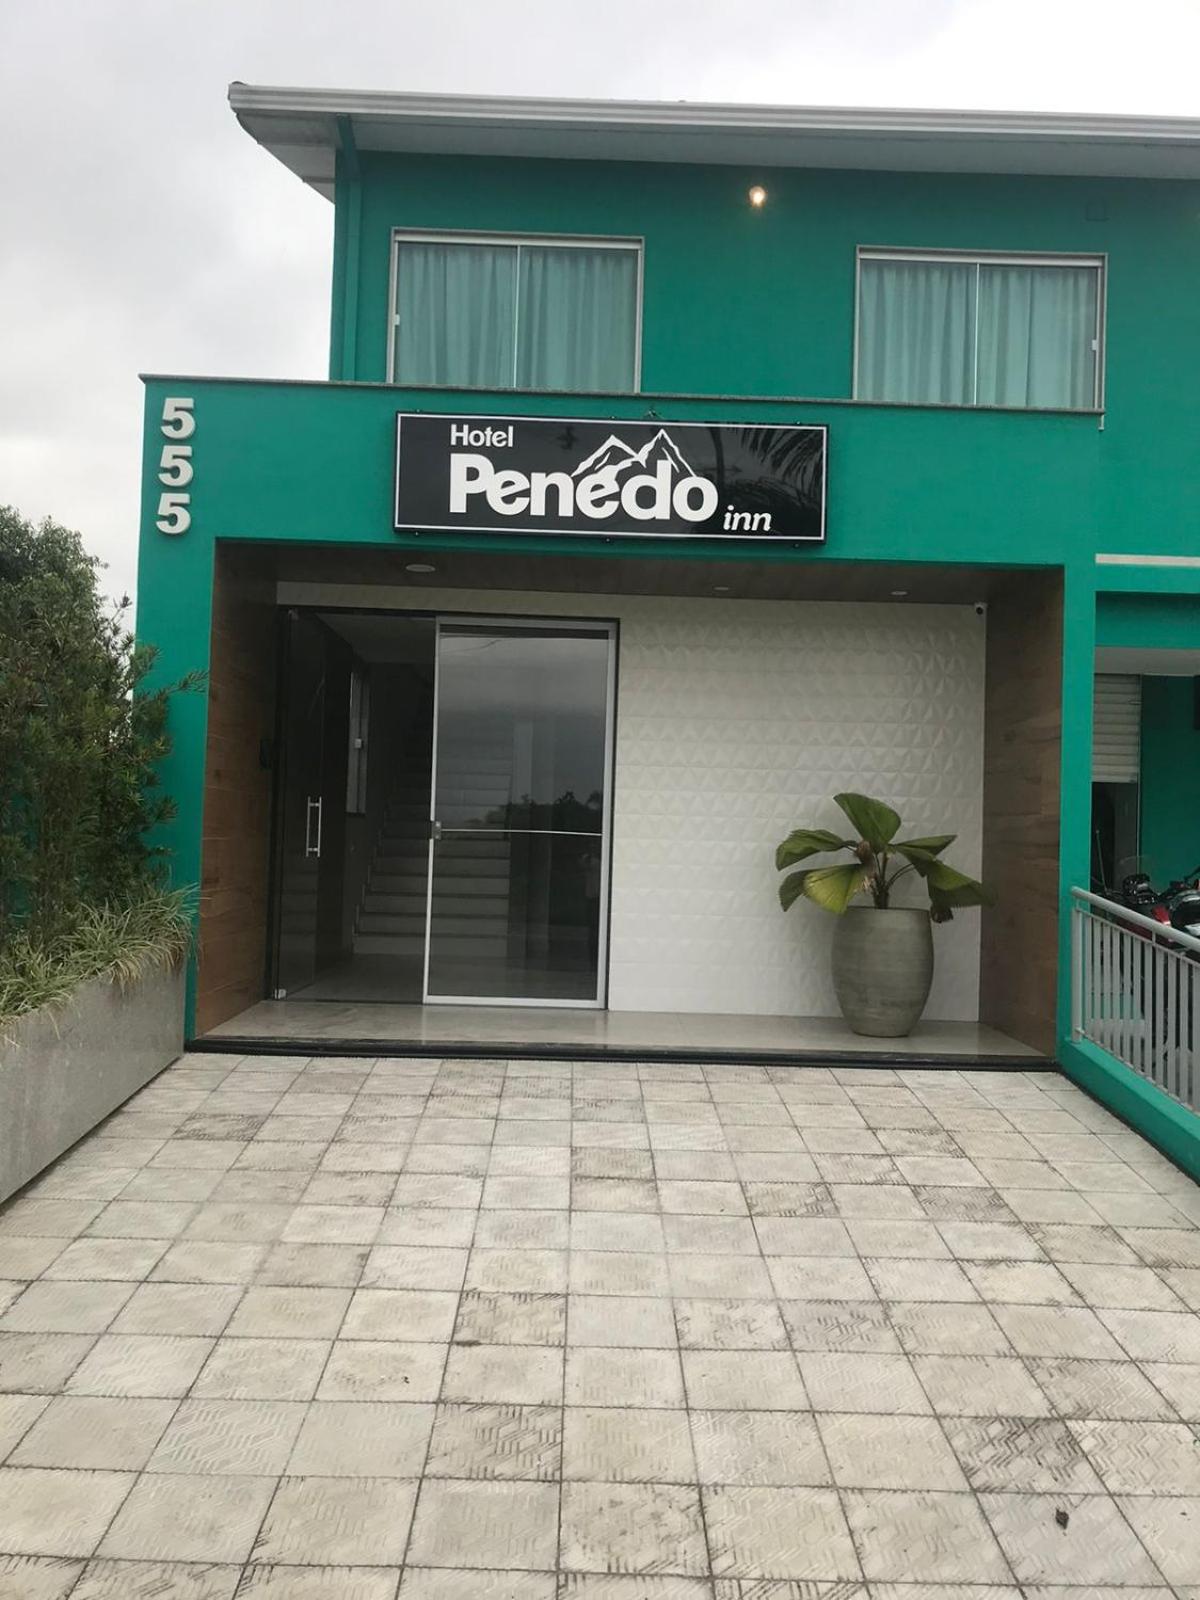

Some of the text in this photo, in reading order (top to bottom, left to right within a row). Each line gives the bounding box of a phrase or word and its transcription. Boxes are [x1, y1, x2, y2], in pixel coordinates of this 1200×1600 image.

[450, 424, 514, 448] Hotel
[156, 397, 196, 535] 555
[449, 452, 719, 522] Penedo
[722, 504, 772, 532] inn
